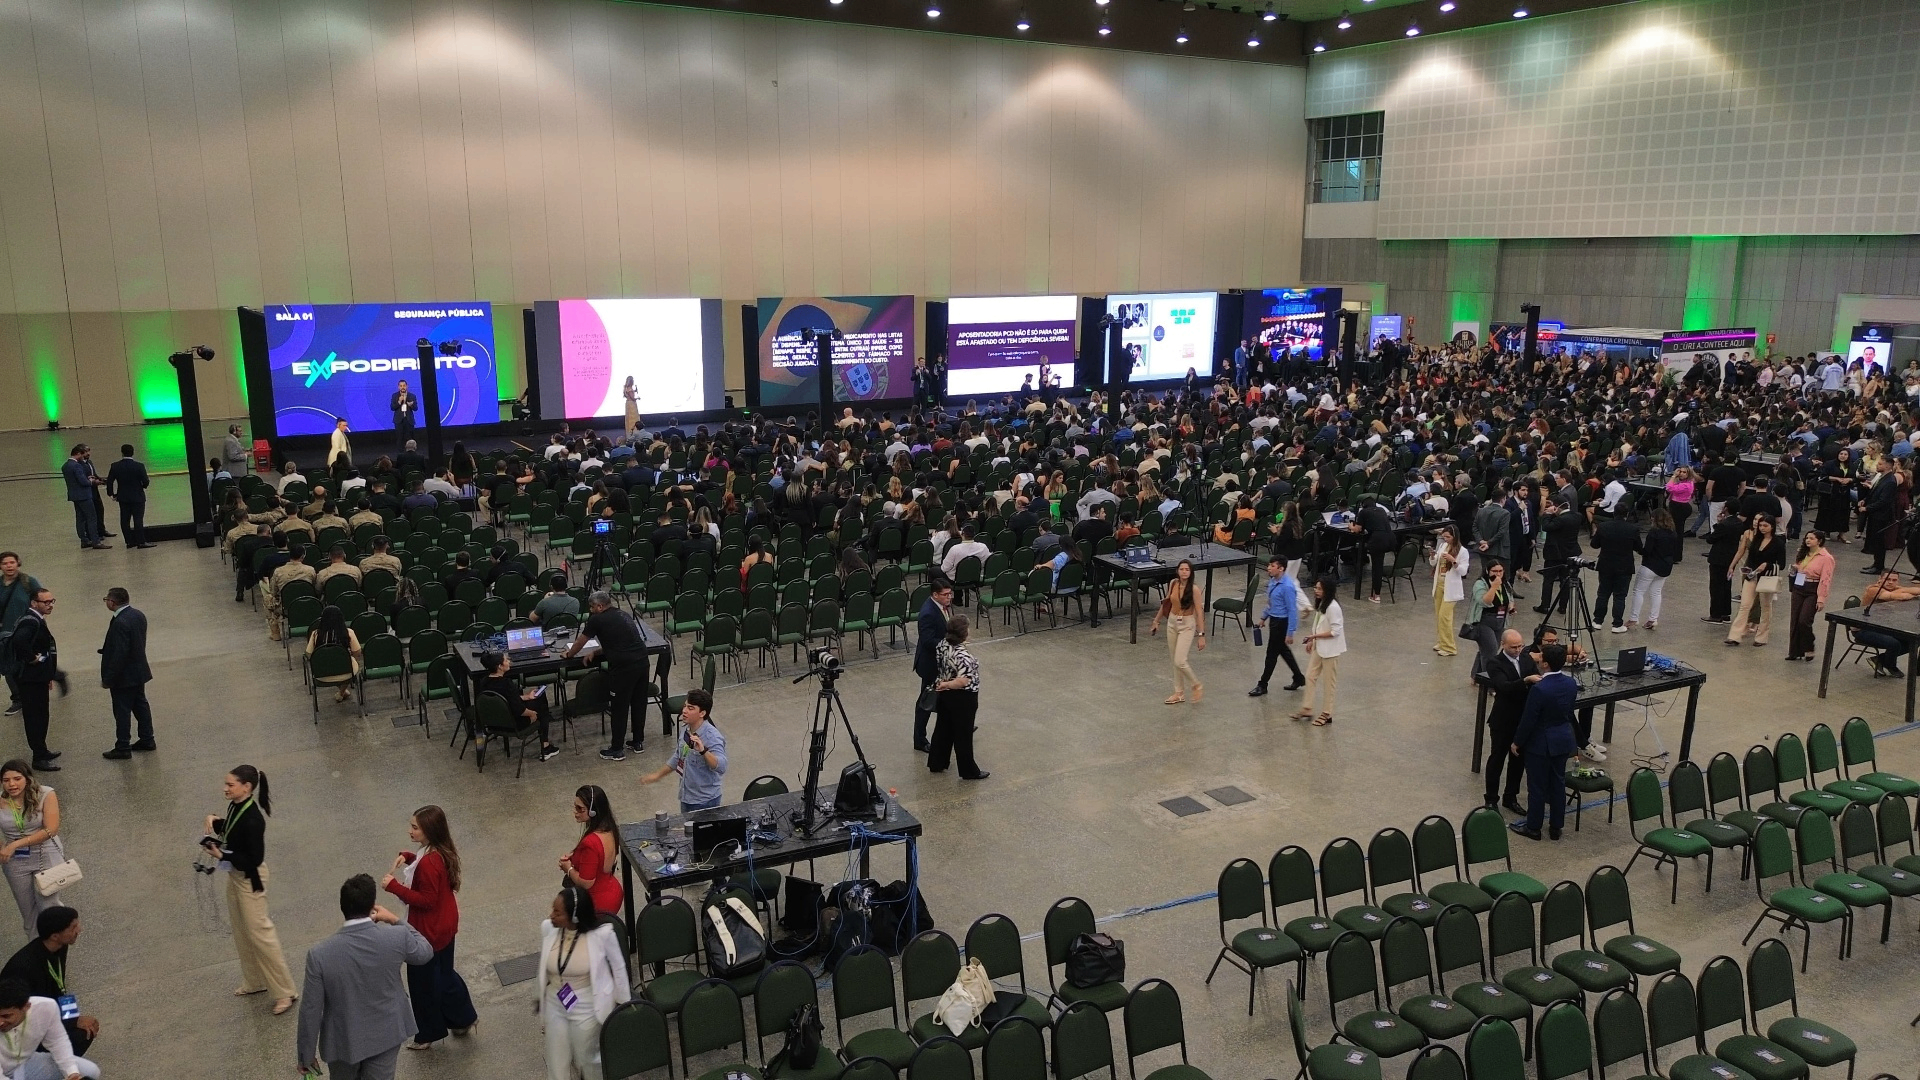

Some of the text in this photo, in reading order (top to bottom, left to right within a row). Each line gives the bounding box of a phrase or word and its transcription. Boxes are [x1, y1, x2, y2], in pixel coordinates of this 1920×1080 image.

[276, 313, 300, 321] SALA
[394, 308, 484, 319] SEGURANÇA PÚBLICA
[958, 331, 1002, 339] APOSENTADORIA
[1015, 328, 1026, 336] NÃO
[1018, 336, 1048, 344] DEFICIÊNCIA
[1580, 336, 1643, 346] CONFRARIA CRIMINAL
[1696, 340, 1728, 349] ACONTECE
[1730, 339, 1745, 347] AQUI
[292, 351, 477, 388] EXPODIRITO
